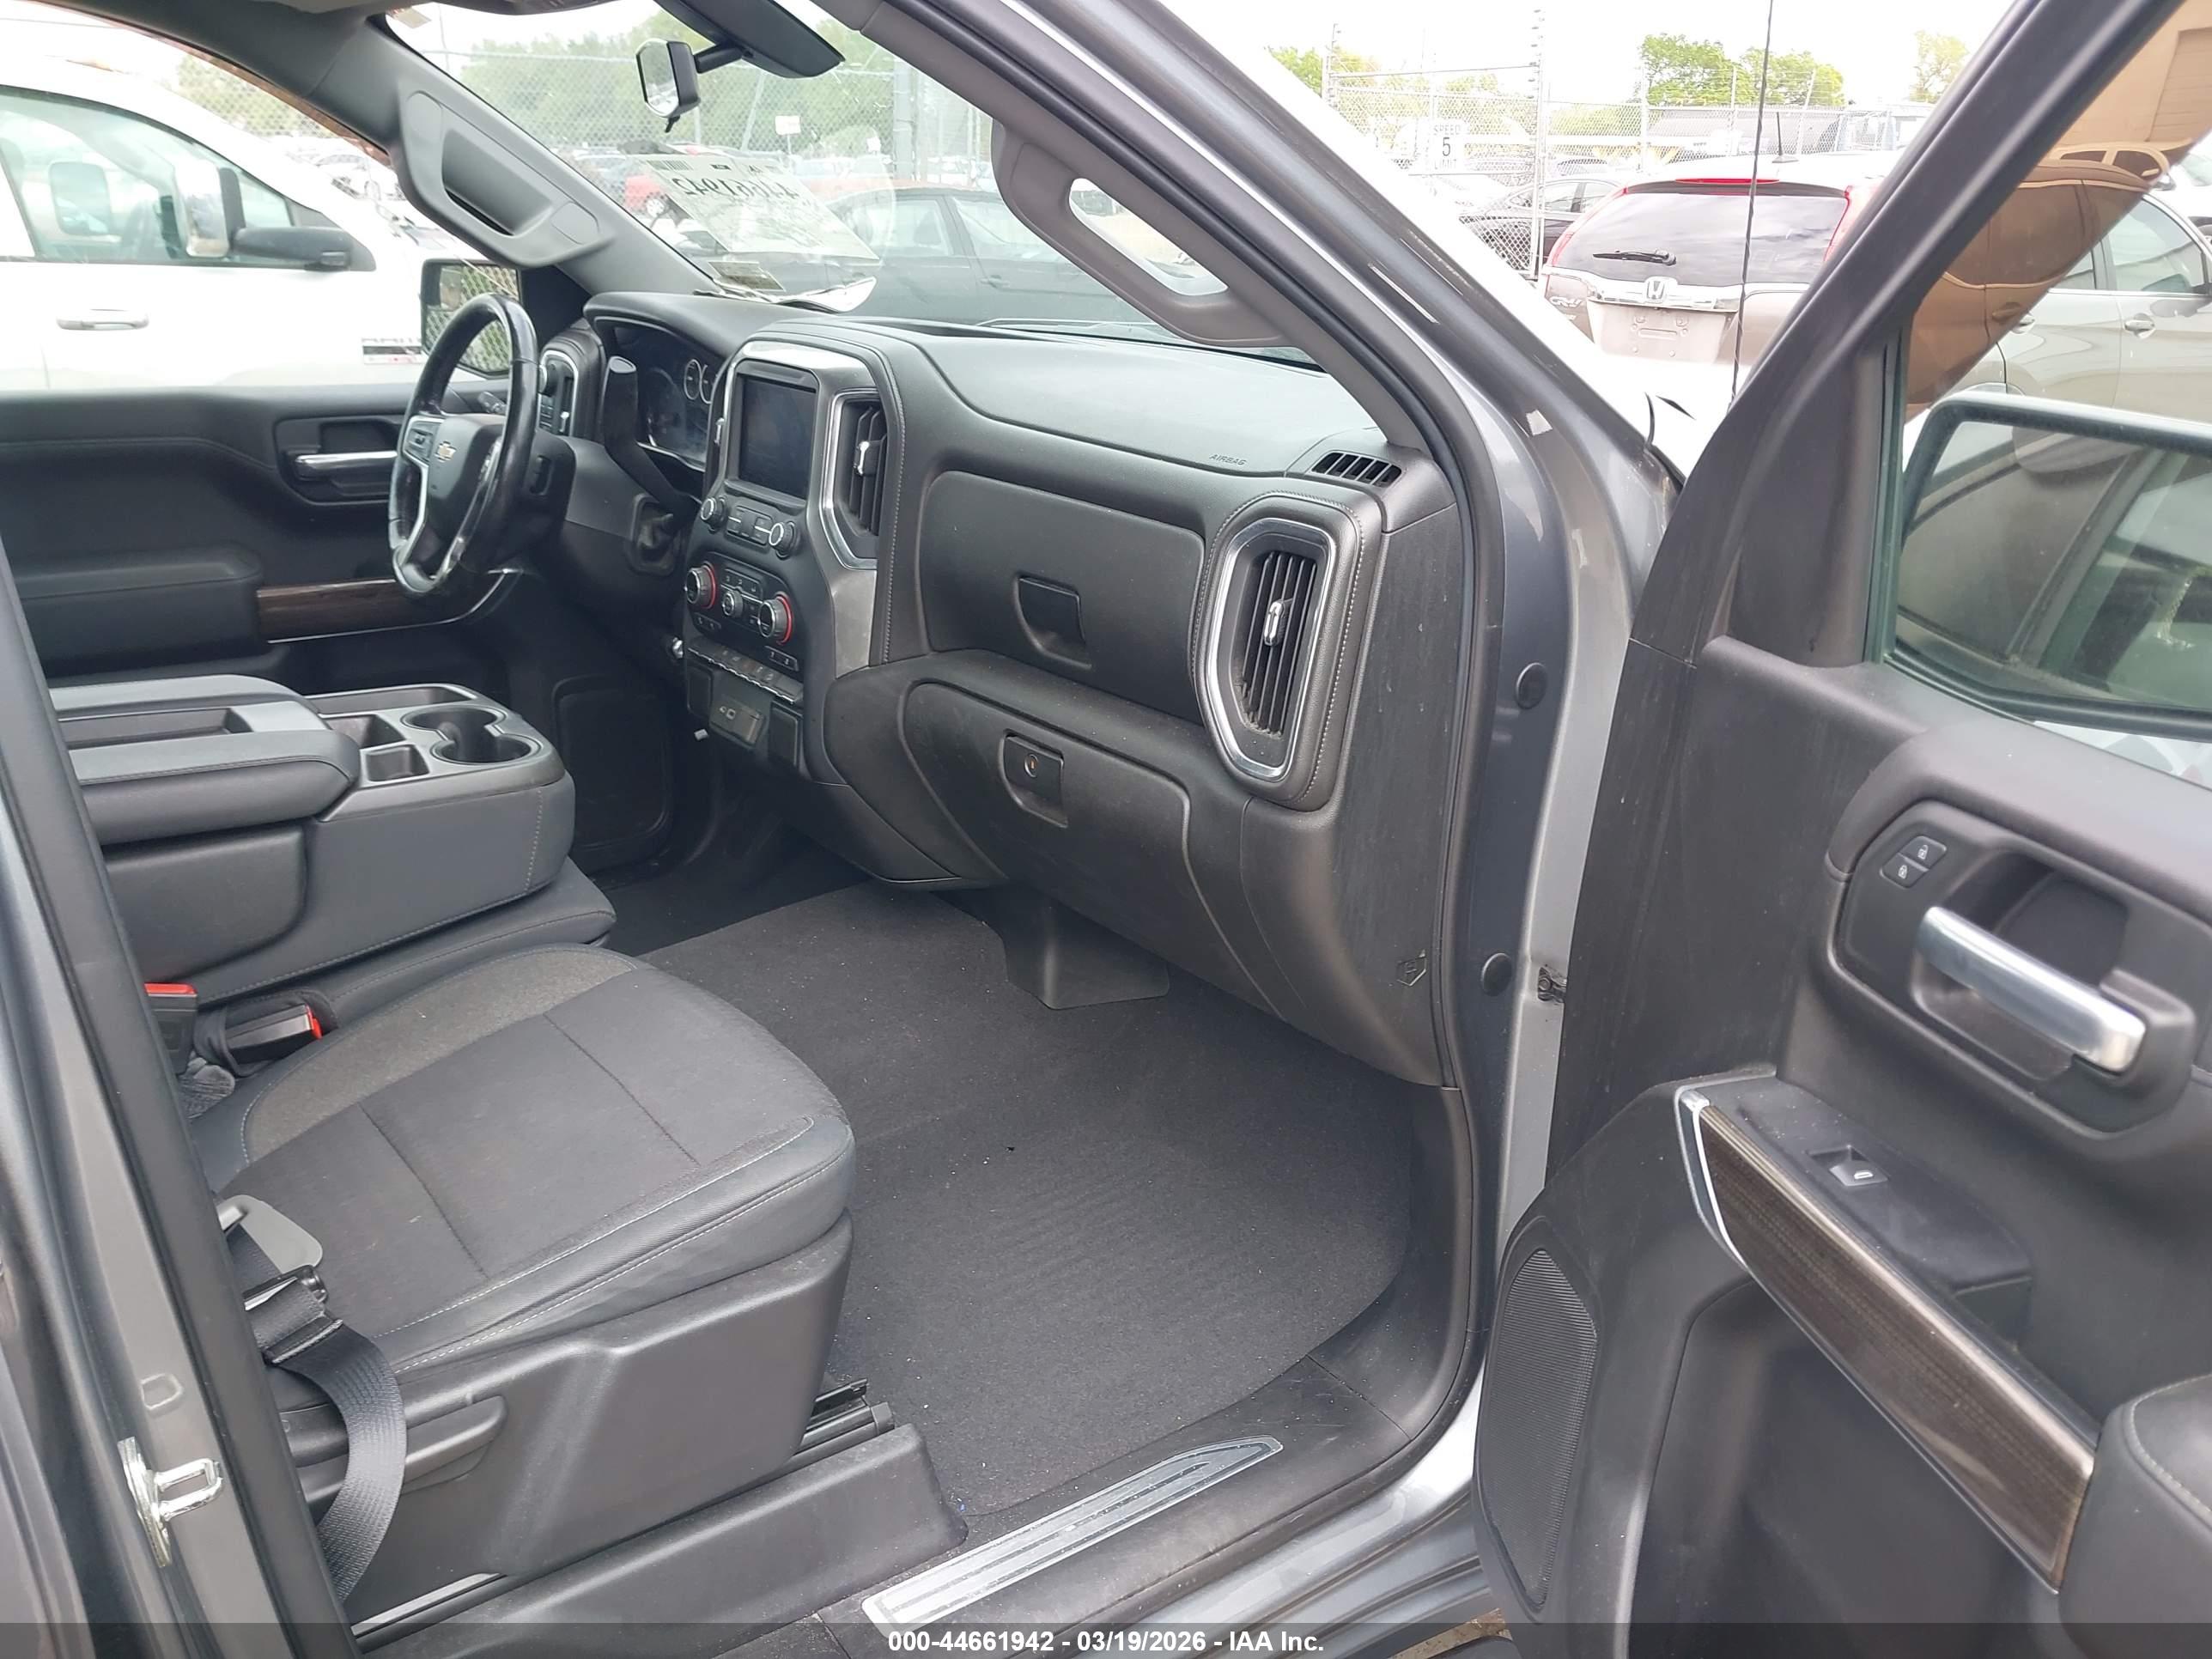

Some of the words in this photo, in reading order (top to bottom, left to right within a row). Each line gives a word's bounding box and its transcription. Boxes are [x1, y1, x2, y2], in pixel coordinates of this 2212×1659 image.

[1433, 124, 1461, 136] SPEED
[1443, 137, 1451, 156] 5
[1435, 158, 1457, 170] LIMIT
[1208, 453, 1247, 465] AIRBAG
